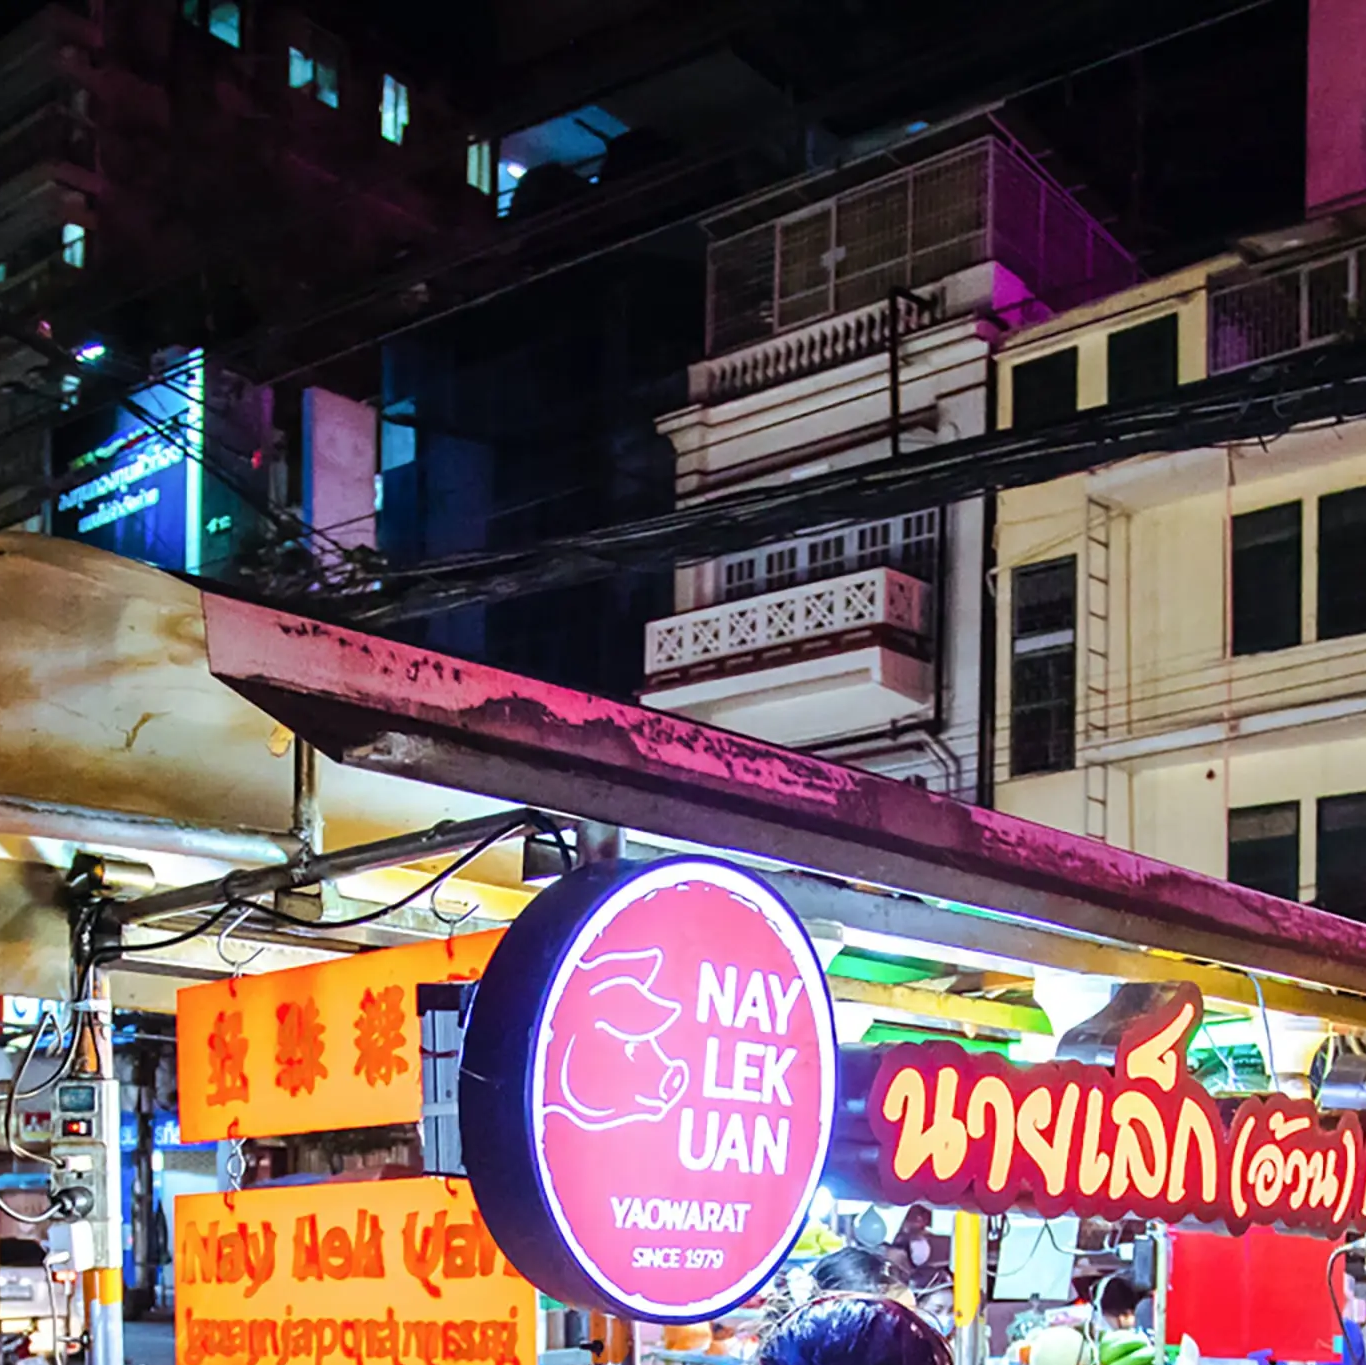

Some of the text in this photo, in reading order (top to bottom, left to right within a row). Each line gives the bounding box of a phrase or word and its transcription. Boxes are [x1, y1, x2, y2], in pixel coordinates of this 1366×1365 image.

[696, 963, 805, 1036] NAY
[703, 1044, 795, 1108] LEK
[883, 1001, 1218, 1206] นายเล็ก
[1230, 1109, 1356, 1220] (อ้วน)
[680, 1120, 788, 1176] UAN
[611, 1197, 751, 1234] YAOWARAT
[631, 1248, 724, 1271] SINCE 1979
